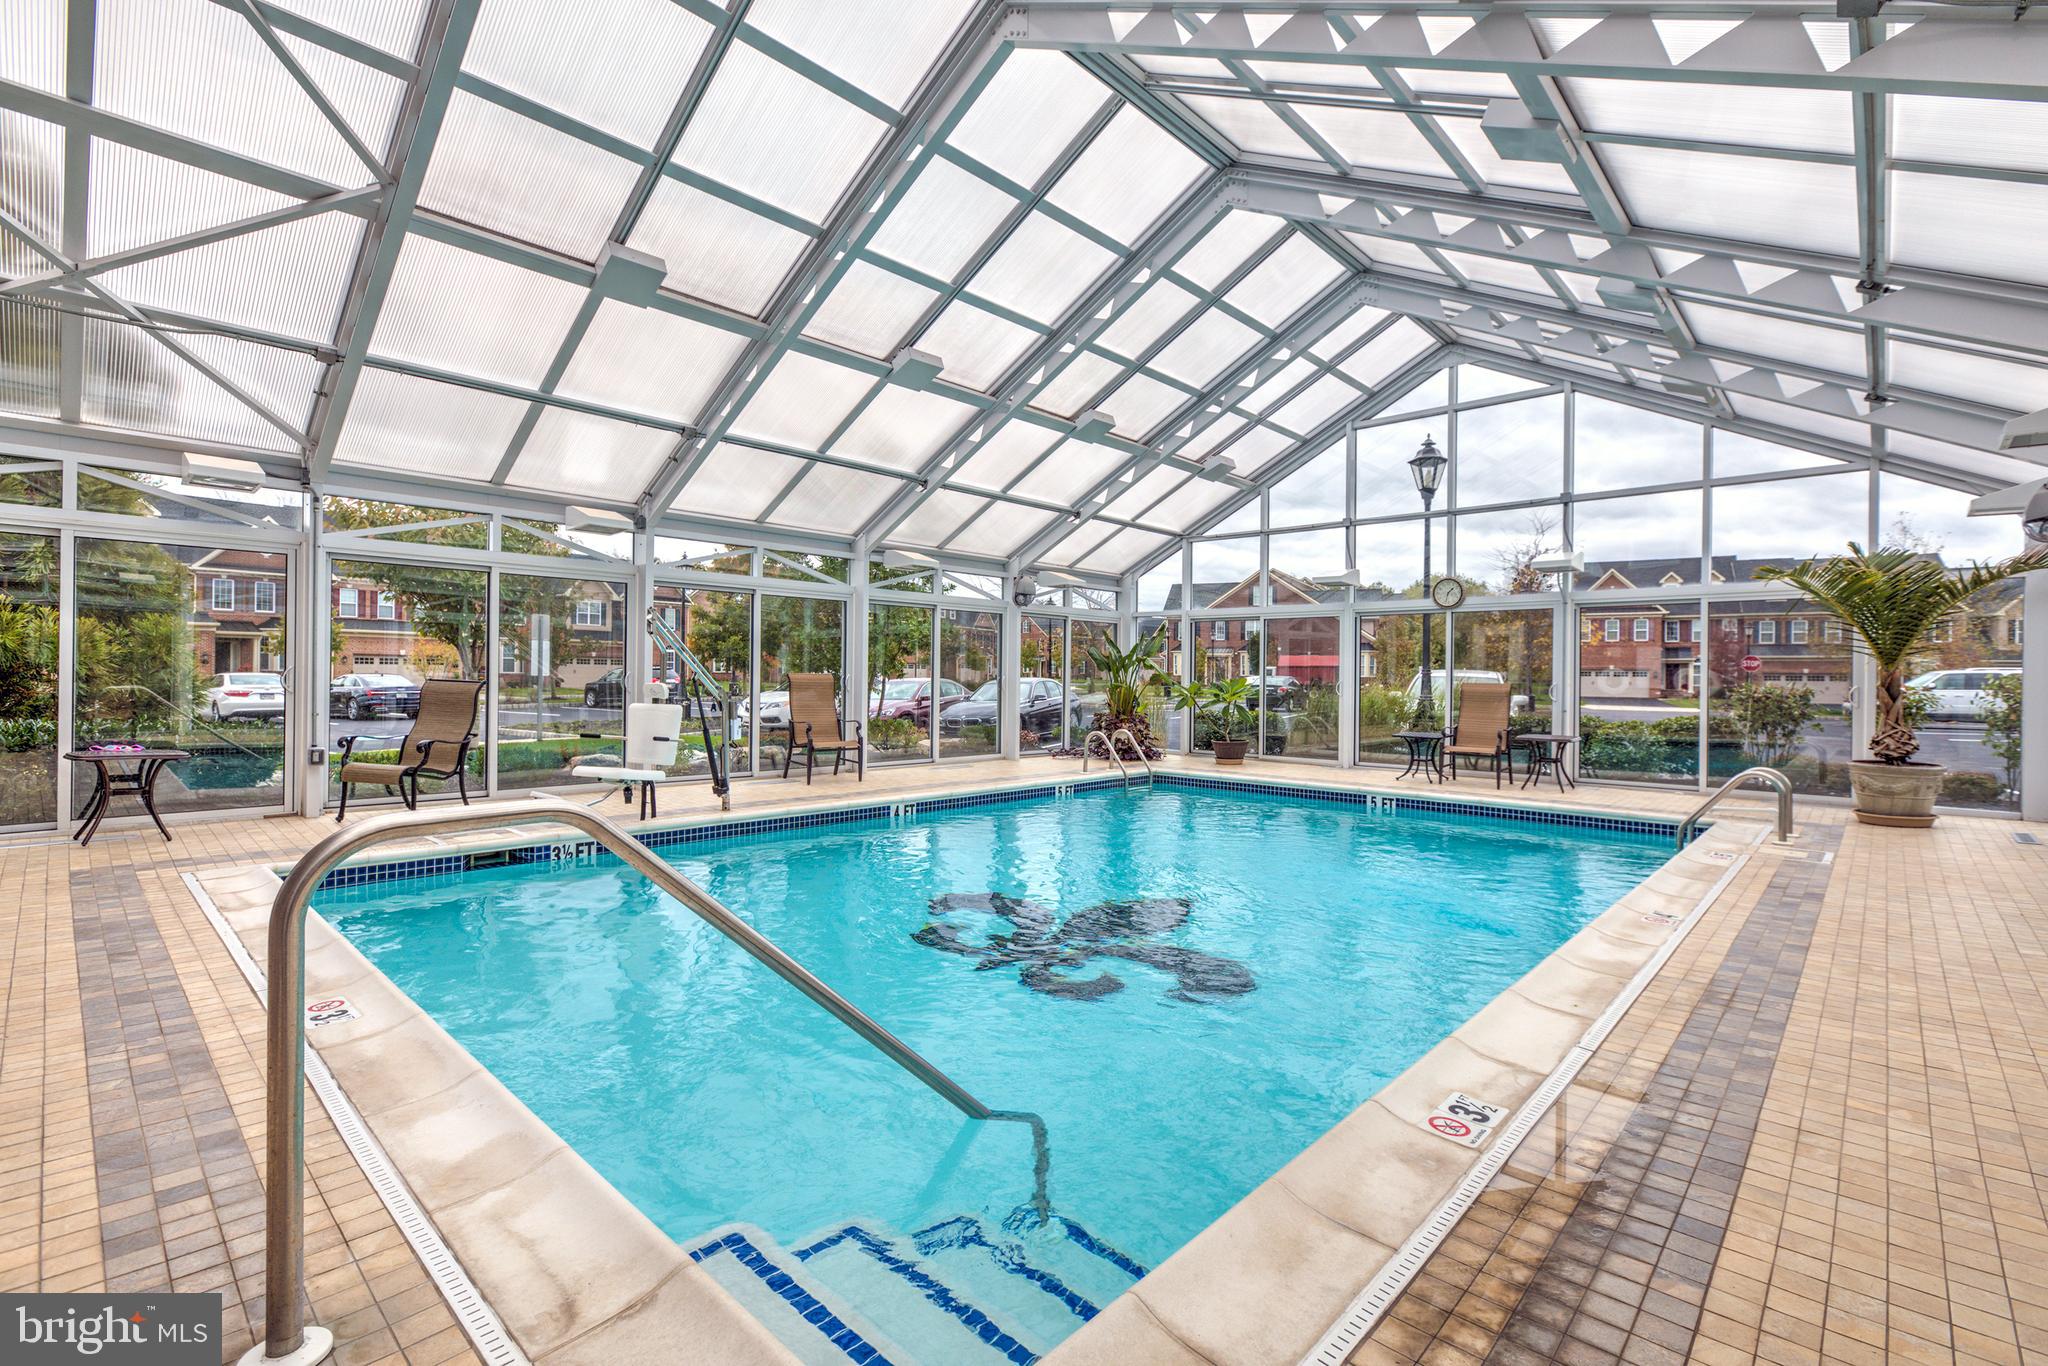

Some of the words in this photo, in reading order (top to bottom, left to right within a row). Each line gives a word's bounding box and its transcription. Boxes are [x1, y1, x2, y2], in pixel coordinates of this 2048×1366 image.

[1382, 797, 1394, 808] FT
[904, 804, 915, 816] FT
[576, 841, 595, 858] FT
